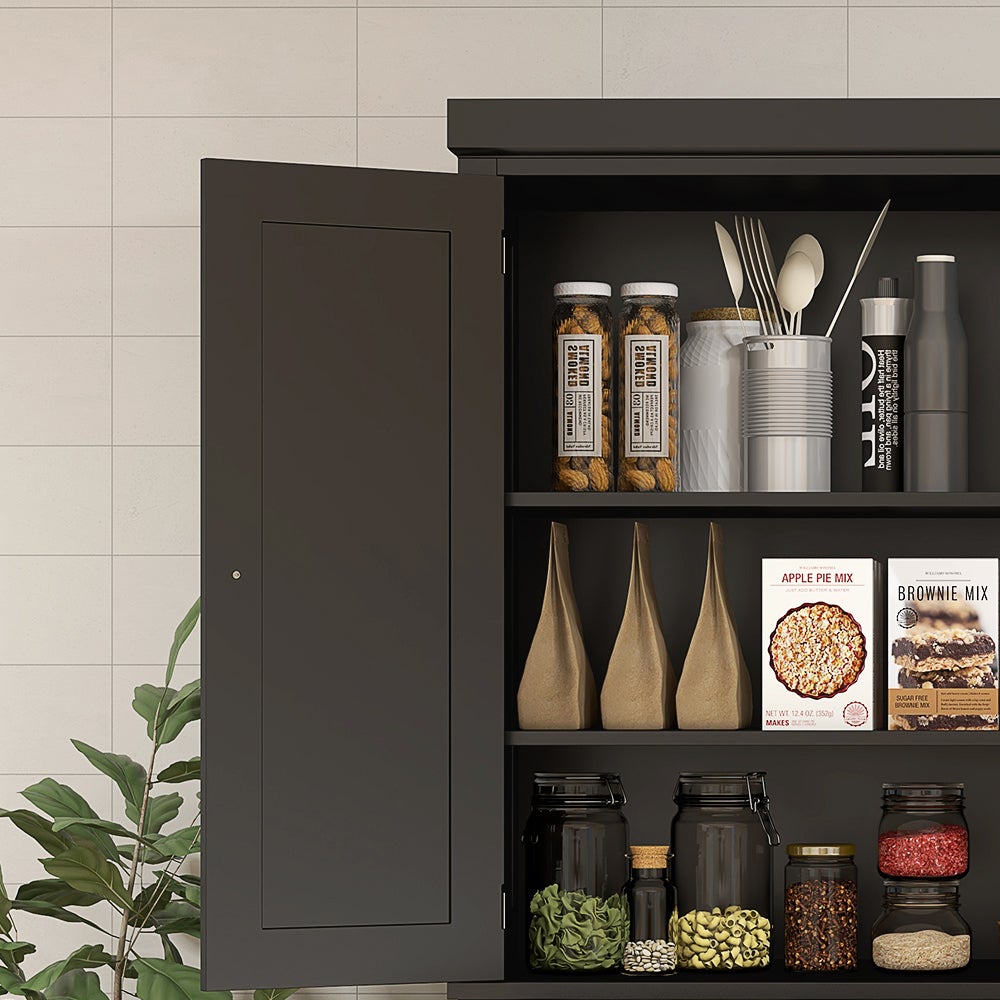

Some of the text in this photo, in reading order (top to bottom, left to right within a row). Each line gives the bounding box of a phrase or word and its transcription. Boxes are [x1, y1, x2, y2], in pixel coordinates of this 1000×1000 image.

[781, 573, 853, 583] APPLE PIE MIX
[898, 585, 988, 601] BROWNIE MIX
